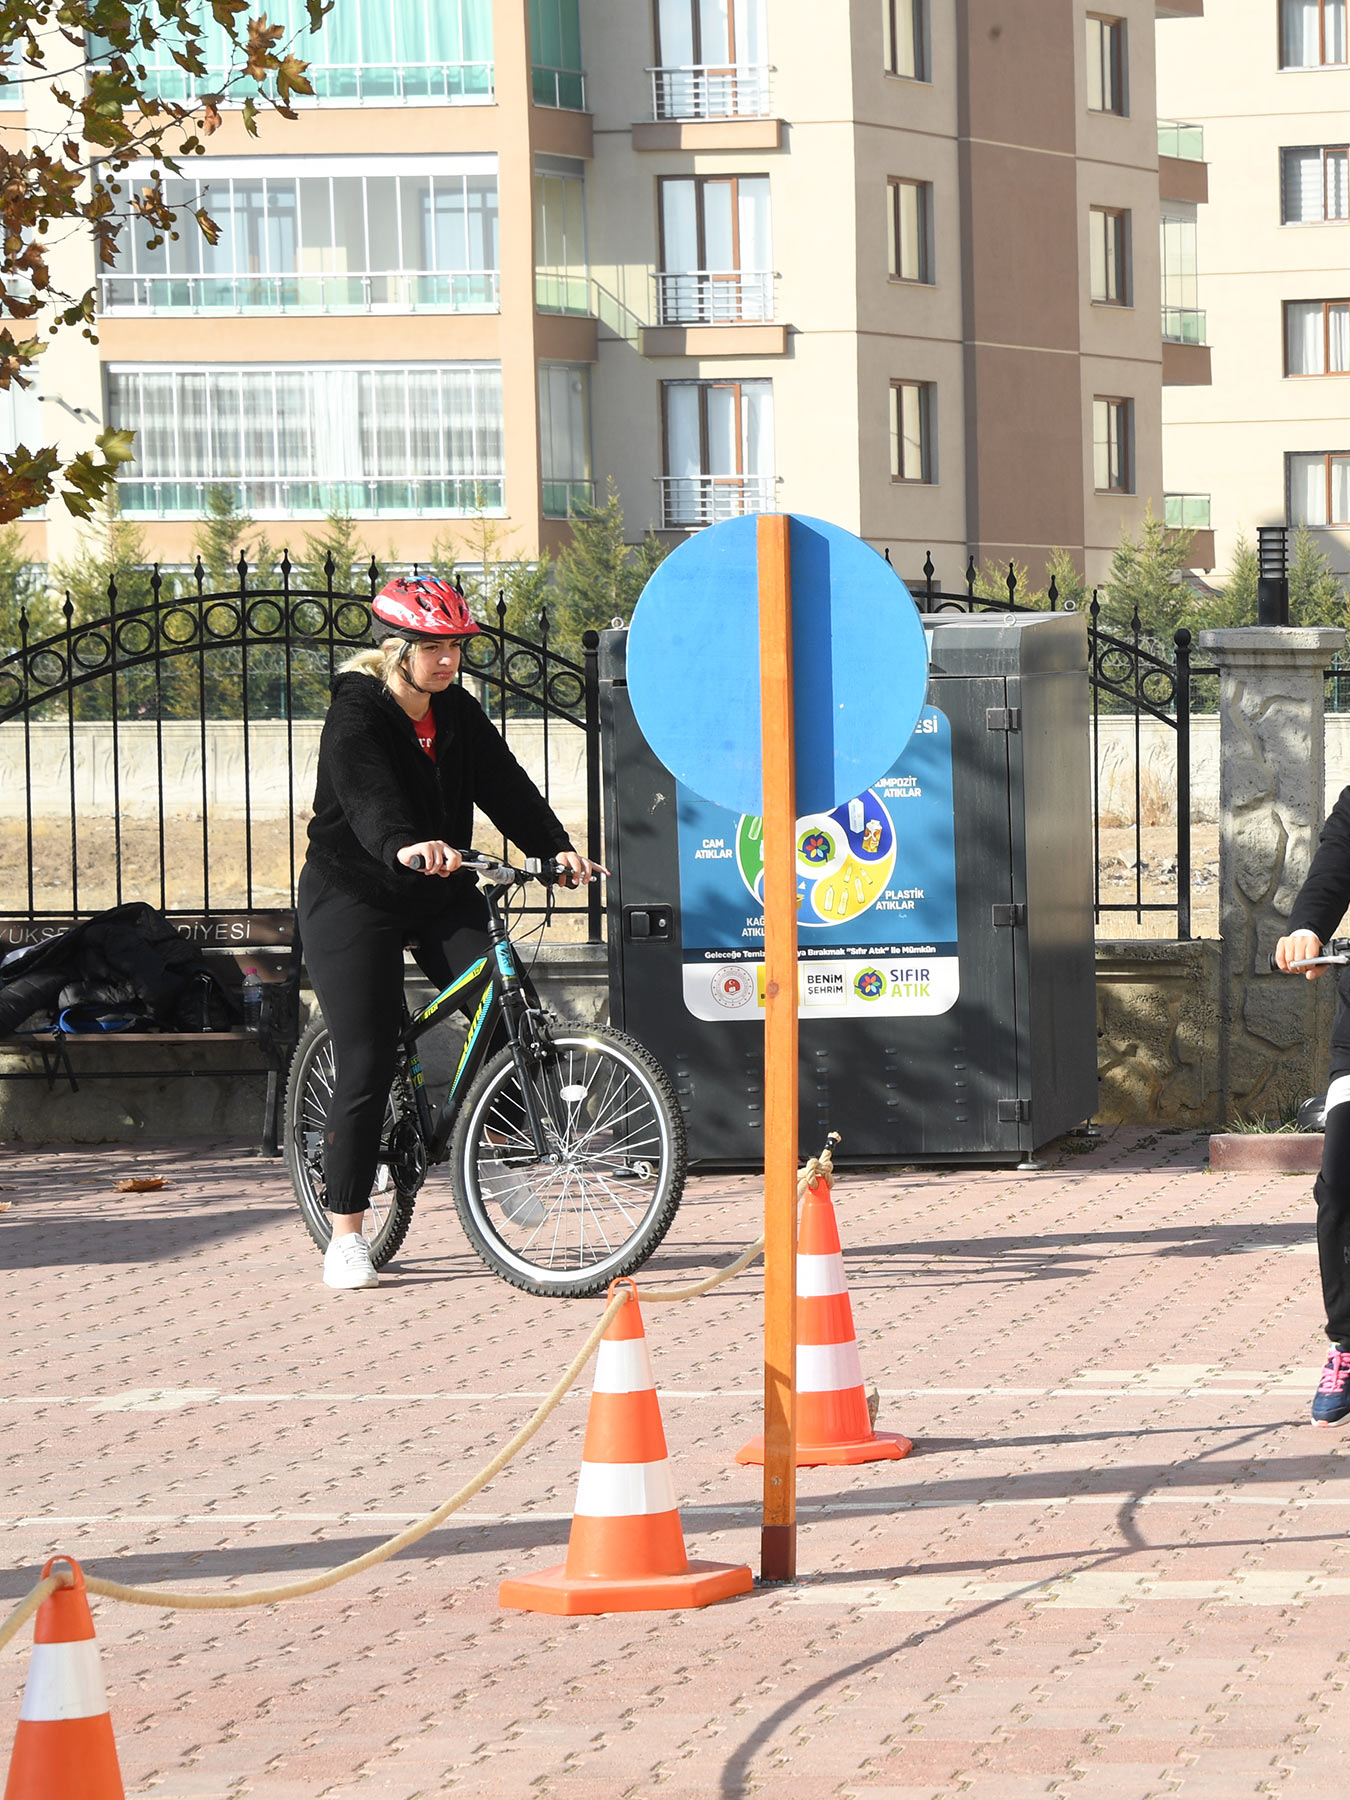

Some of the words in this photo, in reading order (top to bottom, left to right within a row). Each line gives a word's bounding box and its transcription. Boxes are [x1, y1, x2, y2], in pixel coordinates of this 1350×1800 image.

[883, 788, 922, 798] ATIKLAR
[702, 839, 724, 849] CAM
[695, 849, 733, 859] ATIKLAR
[885, 887, 924, 900] PLASTİK
[875, 900, 915, 910] ATIKLAR
[704, 951, 742, 959] Geleceğe
[808, 948, 845, 956] Bırakmak
[902, 945, 936, 954] Mümkün
[807, 973, 843, 984] BENİM
[890, 968, 931, 982] SIFIR
[807, 984, 844, 995] ŞEHRİM
[891, 984, 931, 998] ATIK
